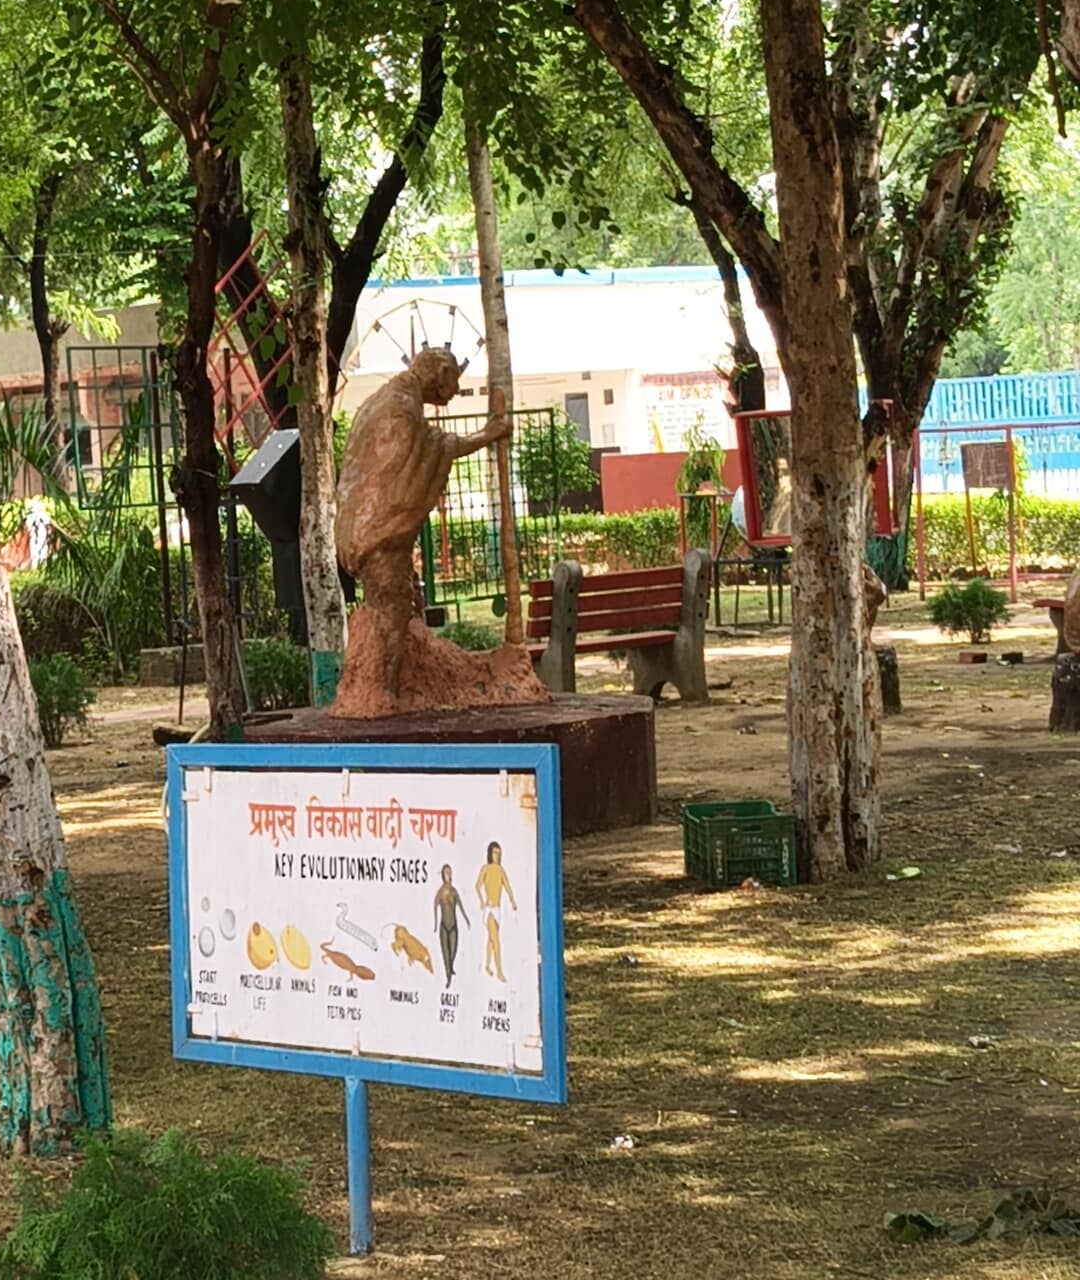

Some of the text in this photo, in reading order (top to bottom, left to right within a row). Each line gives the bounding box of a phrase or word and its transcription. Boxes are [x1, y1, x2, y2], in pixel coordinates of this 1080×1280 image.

[248, 802, 297, 847] प्रमुख
[408, 808, 458, 847] चरण
[274, 853, 429, 884] KEY EVOLUTIONARY STAGES
